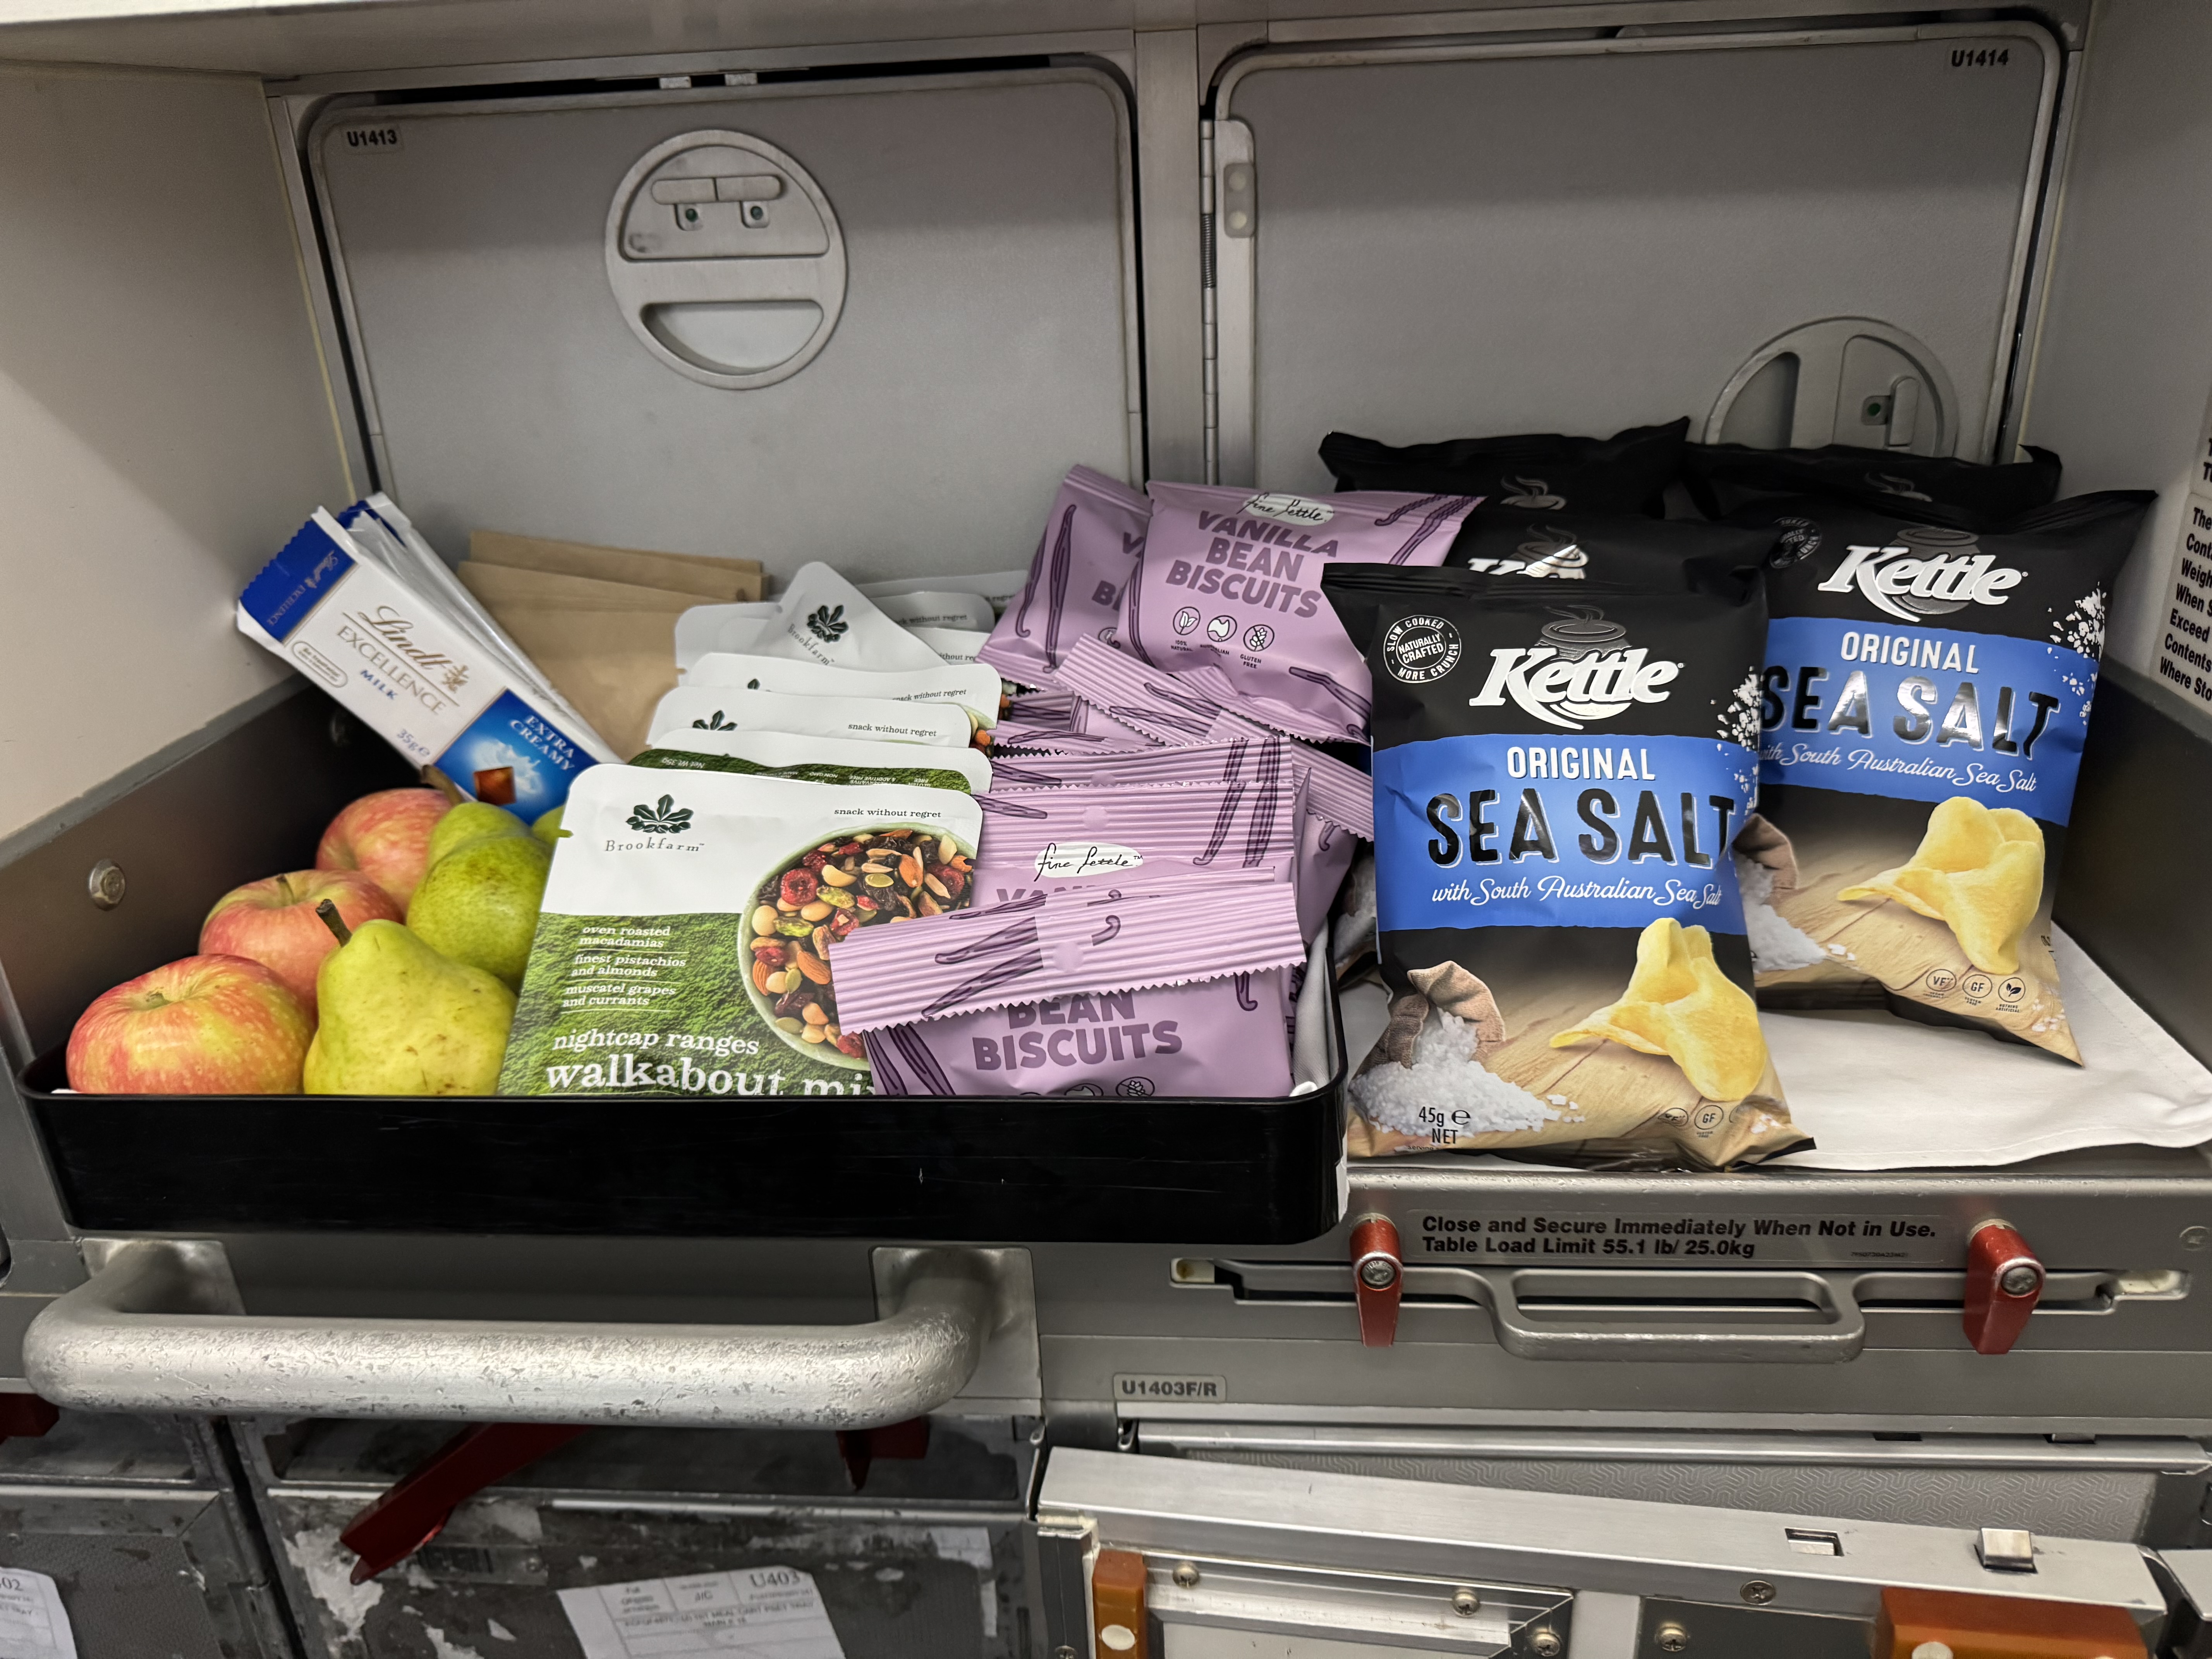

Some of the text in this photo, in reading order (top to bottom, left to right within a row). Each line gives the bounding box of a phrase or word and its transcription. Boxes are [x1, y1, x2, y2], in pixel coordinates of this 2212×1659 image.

[1952, 49, 2008, 67] U1414
[347, 129, 397, 147] U1413
[1197, 510, 1340, 558] VANILLA
[1205, 538, 1304, 581] BEAN
[1166, 560, 1322, 619] BISCUITS
[1817, 545, 2021, 622] Kettle
[2176, 583, 2204, 612] When
[357, 606, 453, 670] Lindt
[1387, 618, 1444, 652] SLOW COOKED
[2170, 608, 2210, 643] Exceed
[939, 652, 963, 661] ithout
[1240, 654, 1261, 663] GLUTEN
[1398, 634, 1441, 654] NATURALLY
[1402, 643, 1444, 664] CRAFTED
[1841, 632, 1979, 674] ORIGINAL
[2165, 633, 2212, 673] Contents
[337, 625, 446, 715] EXCELLENCE
[1398, 644, 1459, 680] MORE CRUNCH
[2160, 656, 2191, 689] Where
[361, 670, 398, 700] MILK
[914, 691, 941, 700] without
[944, 689, 967, 697] regret
[1469, 647, 1679, 729] Kettle
[1762, 665, 2060, 761] SEA SALT
[510, 720, 575, 770] CREAMY
[526, 715, 574, 758] EXTRA
[875, 726, 909, 734] without
[910, 729, 937, 737] regret
[1506, 746, 1655, 781] ORIGINAL
[1779, 743, 1841, 767] South
[1847, 749, 1956, 779] Australian
[1954, 763, 2002, 788] Sea
[1997, 770, 2037, 793] Salt
[1427, 788, 1736, 869] SEA SALT
[1431, 875, 1722, 909] with South Australian Sea Salt
[579, 937, 665, 948] macadamias
[620, 926, 670, 936] roasted
[571, 965, 658, 977] and almonds
[574, 954, 687, 967] finest pistachios
[562, 995, 650, 1007] and currants
[565, 983, 677, 996] muscatel grapes
[1970, 982, 1985, 992] GF
[1007, 991, 1135, 1030] BEAN
[552, 1029, 759, 1057] nightcap ranges
[972, 1020, 1183, 1072] BISCUITS
[546, 1053, 787, 1095] walkabout
[1419, 1106, 1444, 1127] 45g
[1702, 1113, 1716, 1123] GF
[1432, 1128, 1458, 1144] NET
[1422, 1216, 1936, 1238] Close and Secure Immediately When Not in Use.
[1422, 1237, 1755, 1259] Table Load Limit 55.1 lb/ 25.0kg
[1122, 1380, 1217, 1396] U1403F/R
[0, 1577, 24, 1592] 02
[750, 1571, 800, 1588] U403
